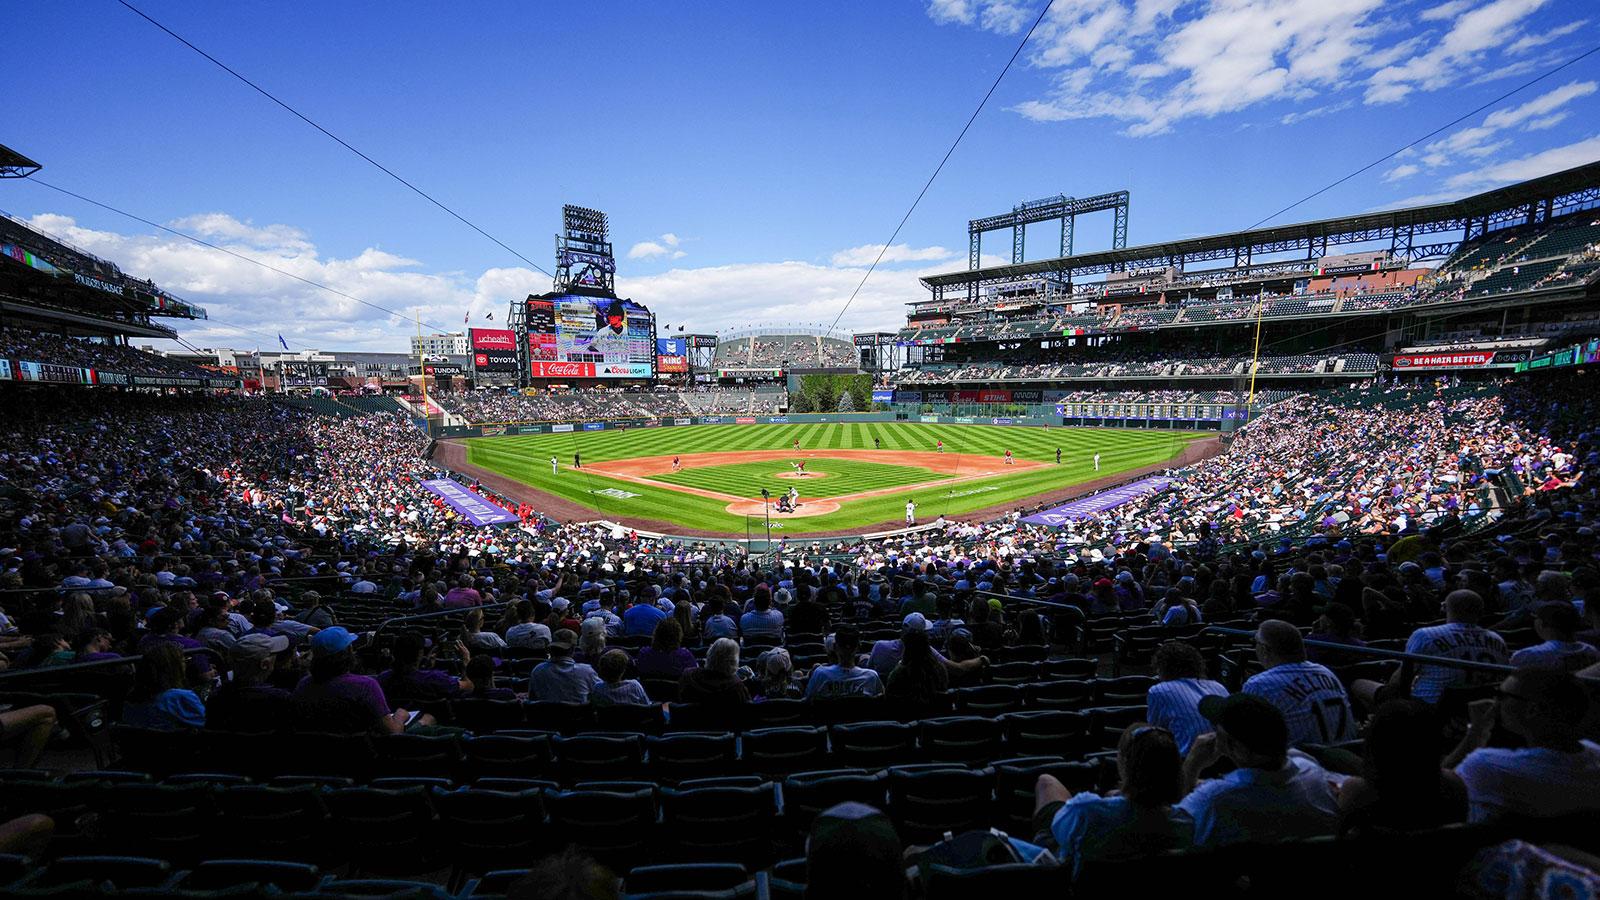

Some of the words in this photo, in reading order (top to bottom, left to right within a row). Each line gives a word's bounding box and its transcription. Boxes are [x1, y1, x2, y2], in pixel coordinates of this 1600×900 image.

[101, 281, 123, 296] SAUSAGE
[479, 334, 510, 343] uchealth
[1313, 698, 1346, 742] 17
